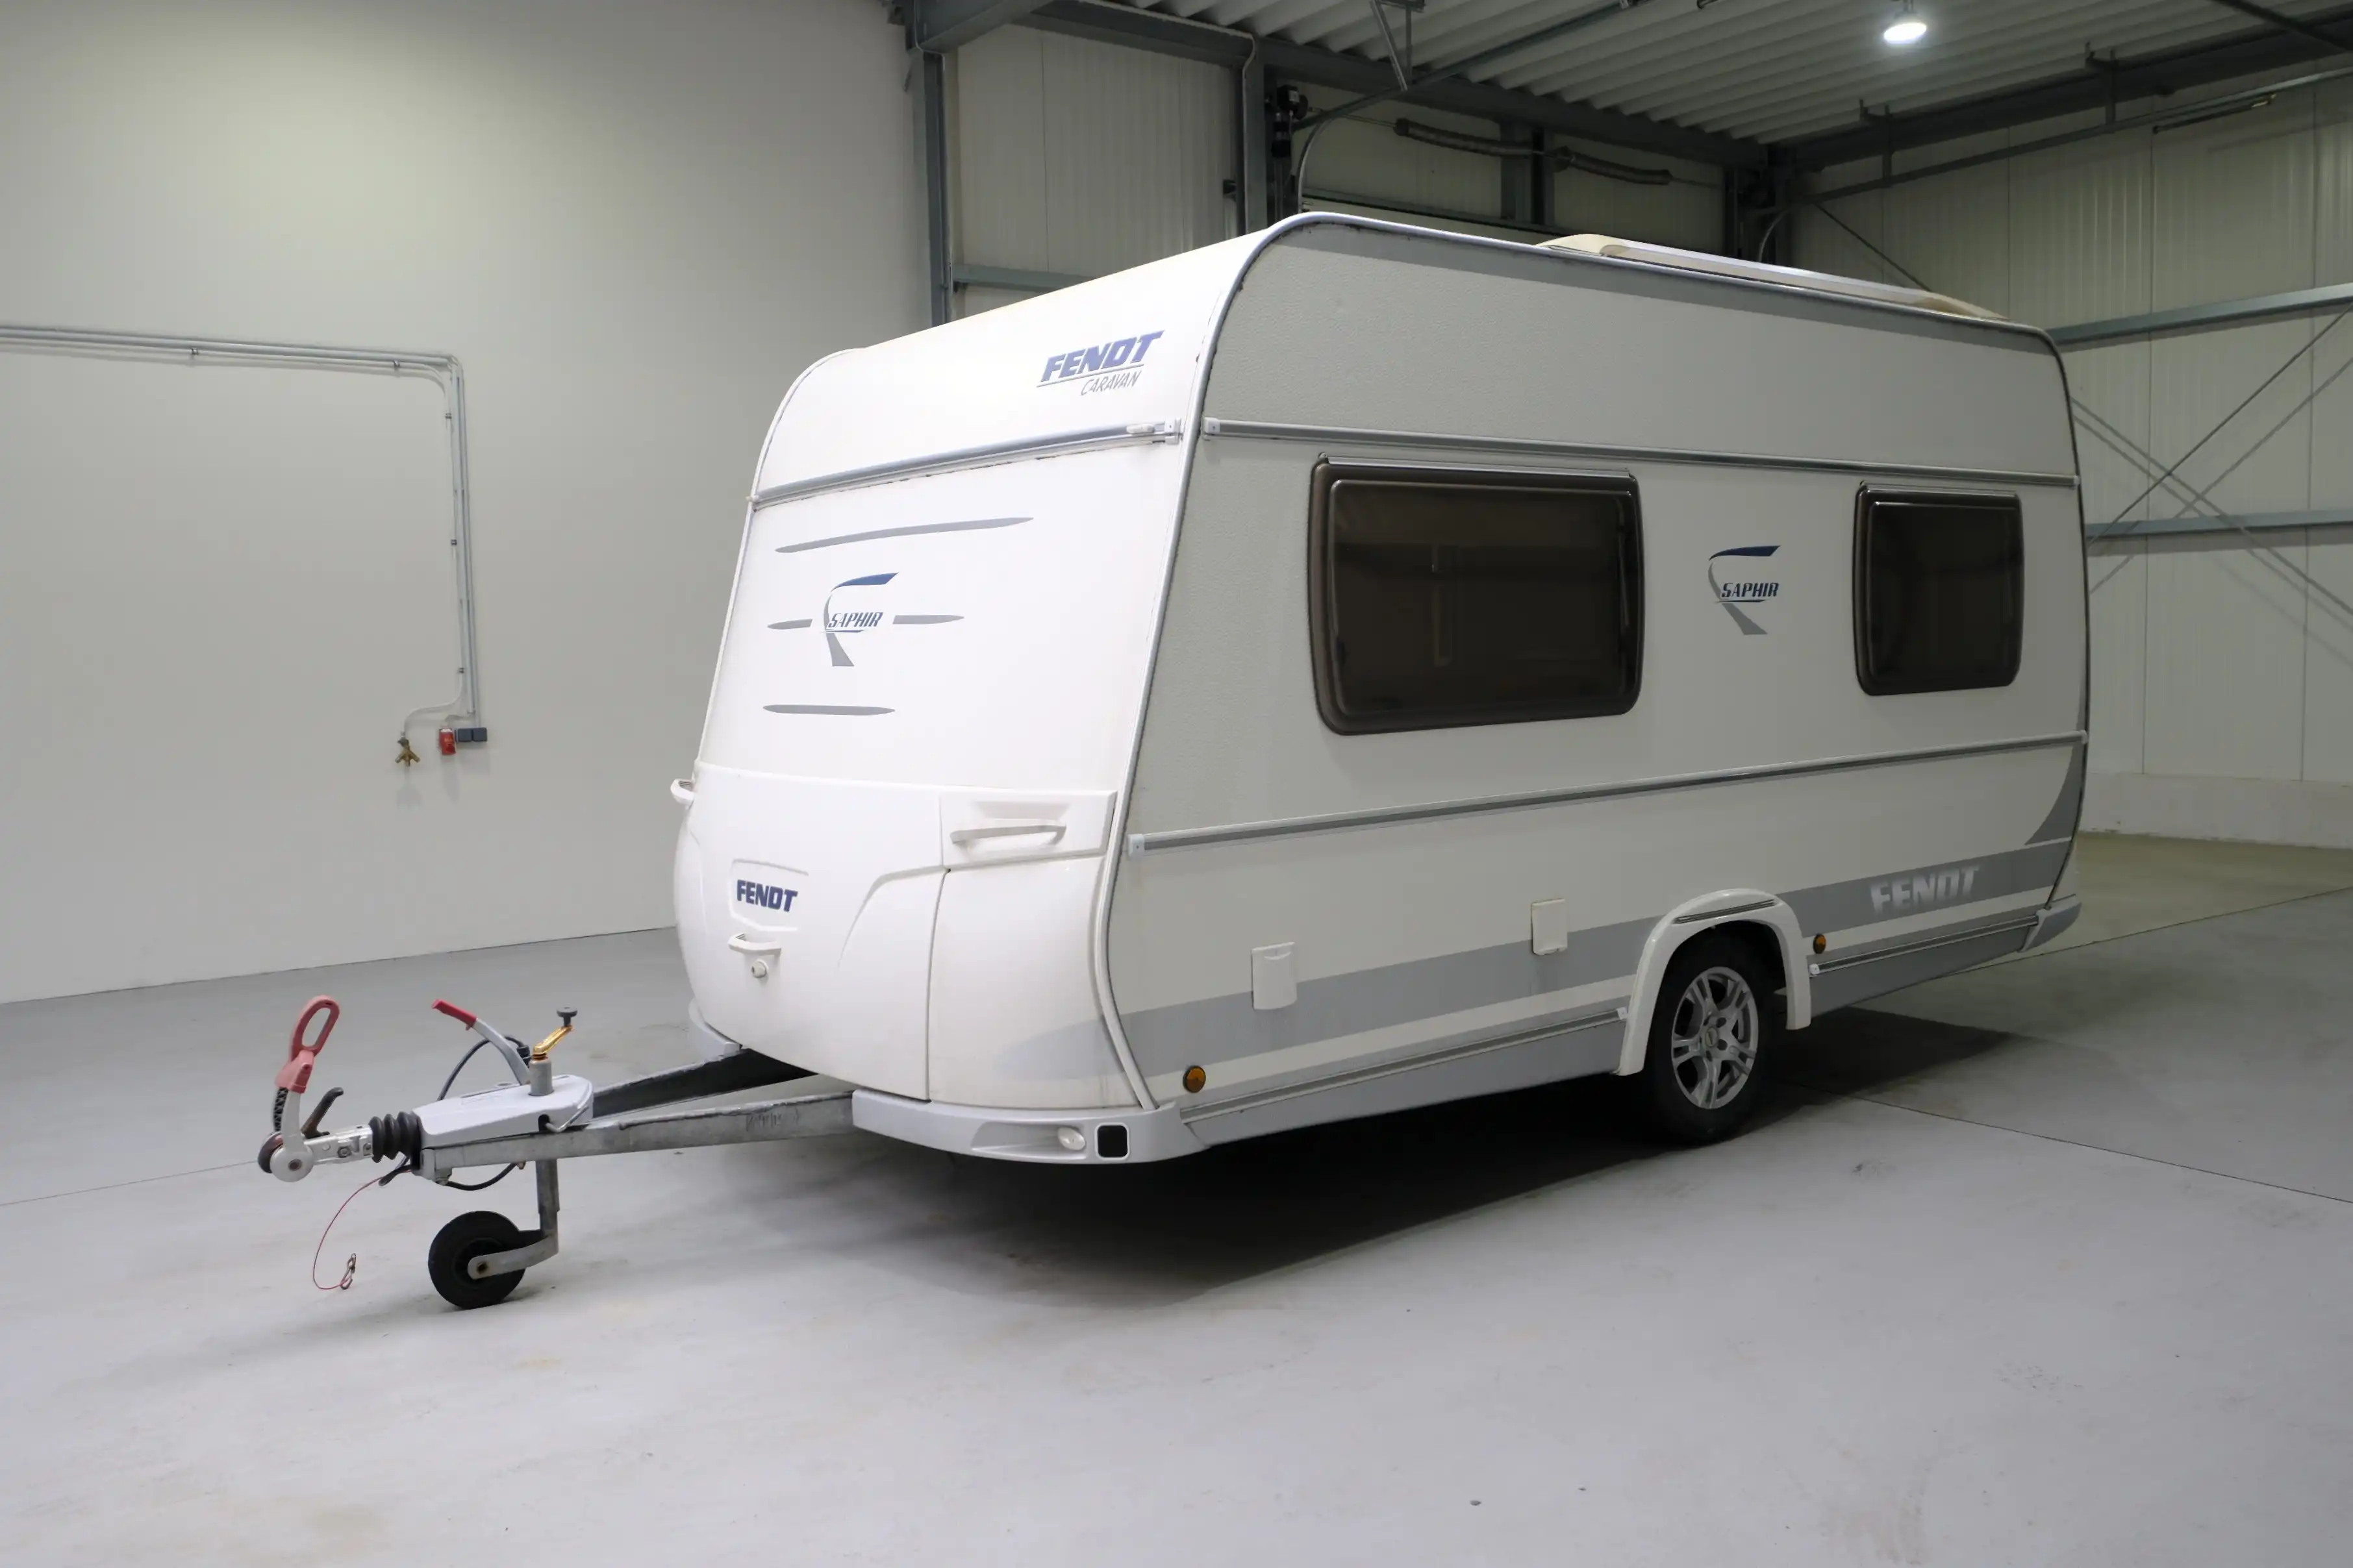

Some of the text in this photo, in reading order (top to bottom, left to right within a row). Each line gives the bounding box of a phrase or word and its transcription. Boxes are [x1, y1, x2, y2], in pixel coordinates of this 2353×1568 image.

[1040, 330, 1165, 382] FENDT
[1079, 370, 1142, 396] CARAVAN
[1721, 582, 1780, 598] SAPHIR
[828, 612, 884, 628] SAPHIR
[736, 879, 798, 912] FENDT
[1870, 864, 1980, 915] FENDT
